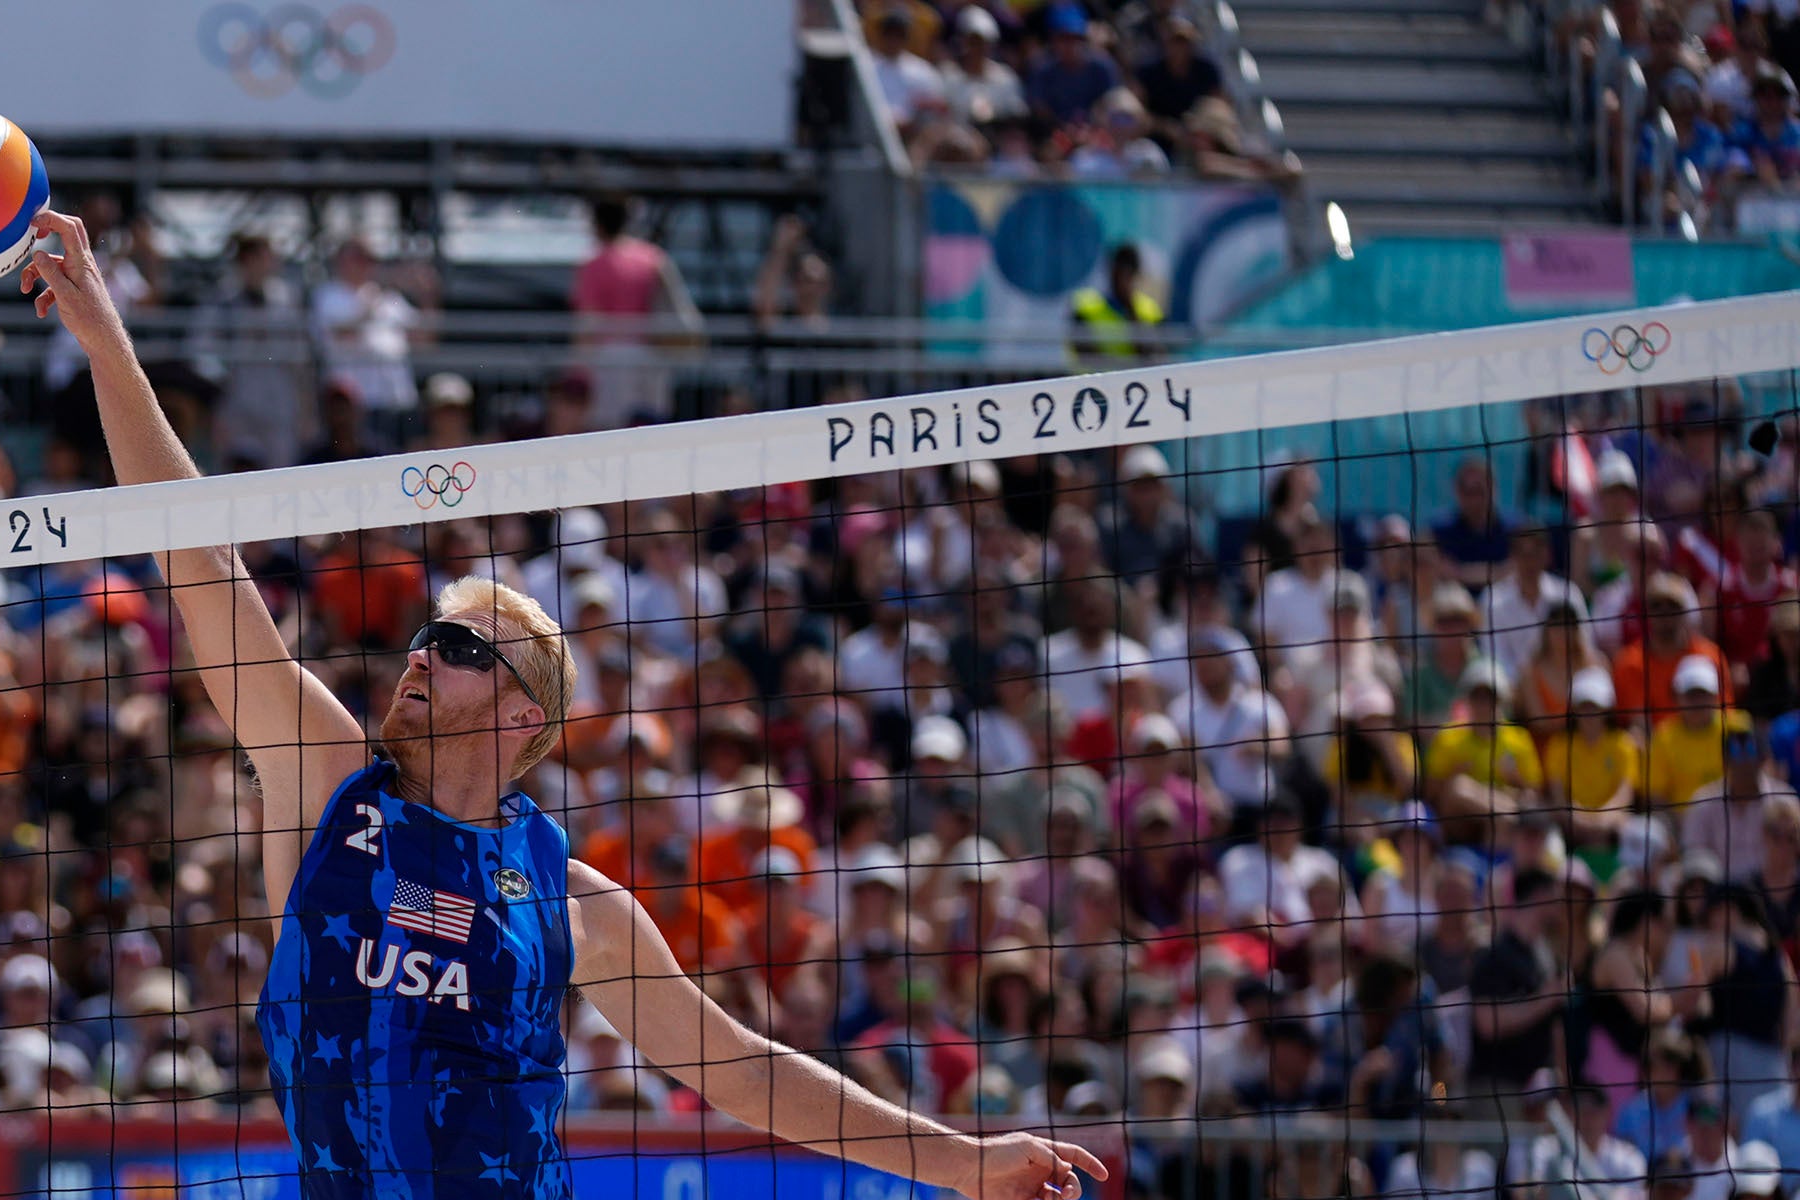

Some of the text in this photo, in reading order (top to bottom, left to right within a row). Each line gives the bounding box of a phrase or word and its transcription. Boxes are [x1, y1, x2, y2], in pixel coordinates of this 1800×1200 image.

[1032, 378, 1191, 438] 2024
[345, 803, 384, 857] 2
[355, 938, 471, 1012] USA
